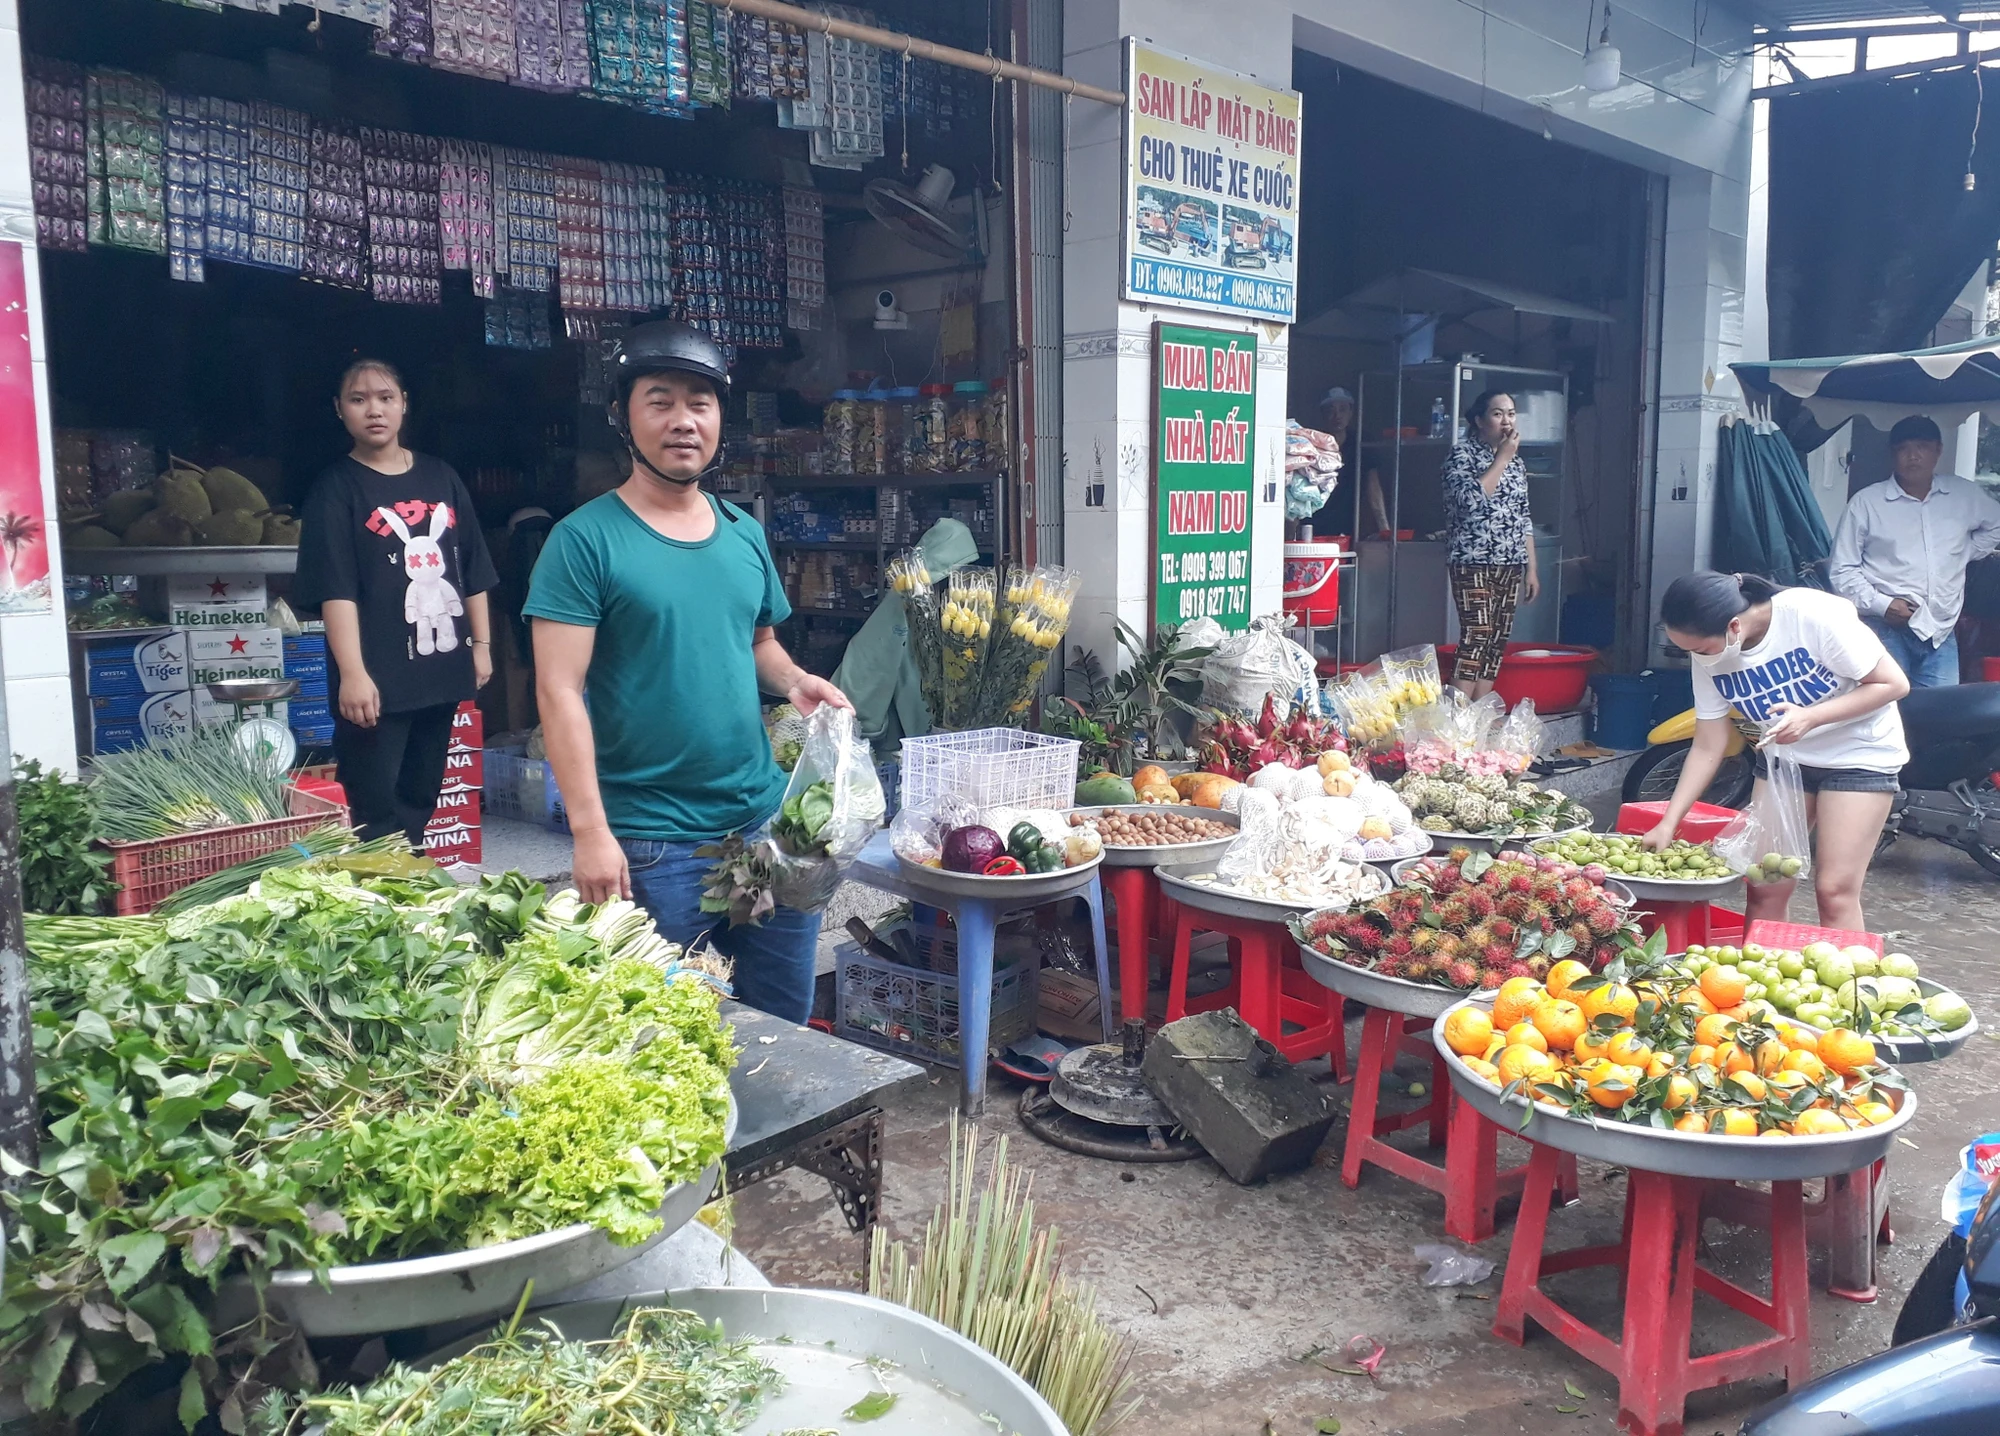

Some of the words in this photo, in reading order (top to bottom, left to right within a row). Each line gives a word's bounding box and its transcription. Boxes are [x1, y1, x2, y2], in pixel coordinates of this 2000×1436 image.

[1138, 72, 1175, 122] SAN
[1180, 77, 1212, 131] LẤP
[1217, 94, 1251, 149] MẶT
[1255, 98, 1296, 156] BẰNG
[1139, 134, 1175, 182] CHO
[1180, 146, 1223, 194] THUÊ
[1228, 157, 1249, 200] XE
[1253, 160, 1293, 211] CUỐC
[1163, 342, 1207, 391] MUA
[1212, 340, 1252, 394] BÁN
[1165, 410, 1206, 463] NHÀ
[1210, 406, 1248, 464] ĐẤT
[1168, 490, 1216, 535] NAM
[1219, 490, 1247, 533] DU
[1161, 553, 1179, 584] TEL:
[1181, 552, 1206, 582] 0909
[1209, 551, 1226, 580] 399
[1228, 550, 1247, 579] 067
[174, 609, 266, 625] Heineken
[1180, 588, 1205, 618] 0918
[1207, 586, 1225, 616] 627
[1227, 585, 1247, 614] 747
[146, 663, 183, 681] Tiger
[193, 665, 283, 685] Heineken
[1712, 647, 1816, 700] DUNDER
